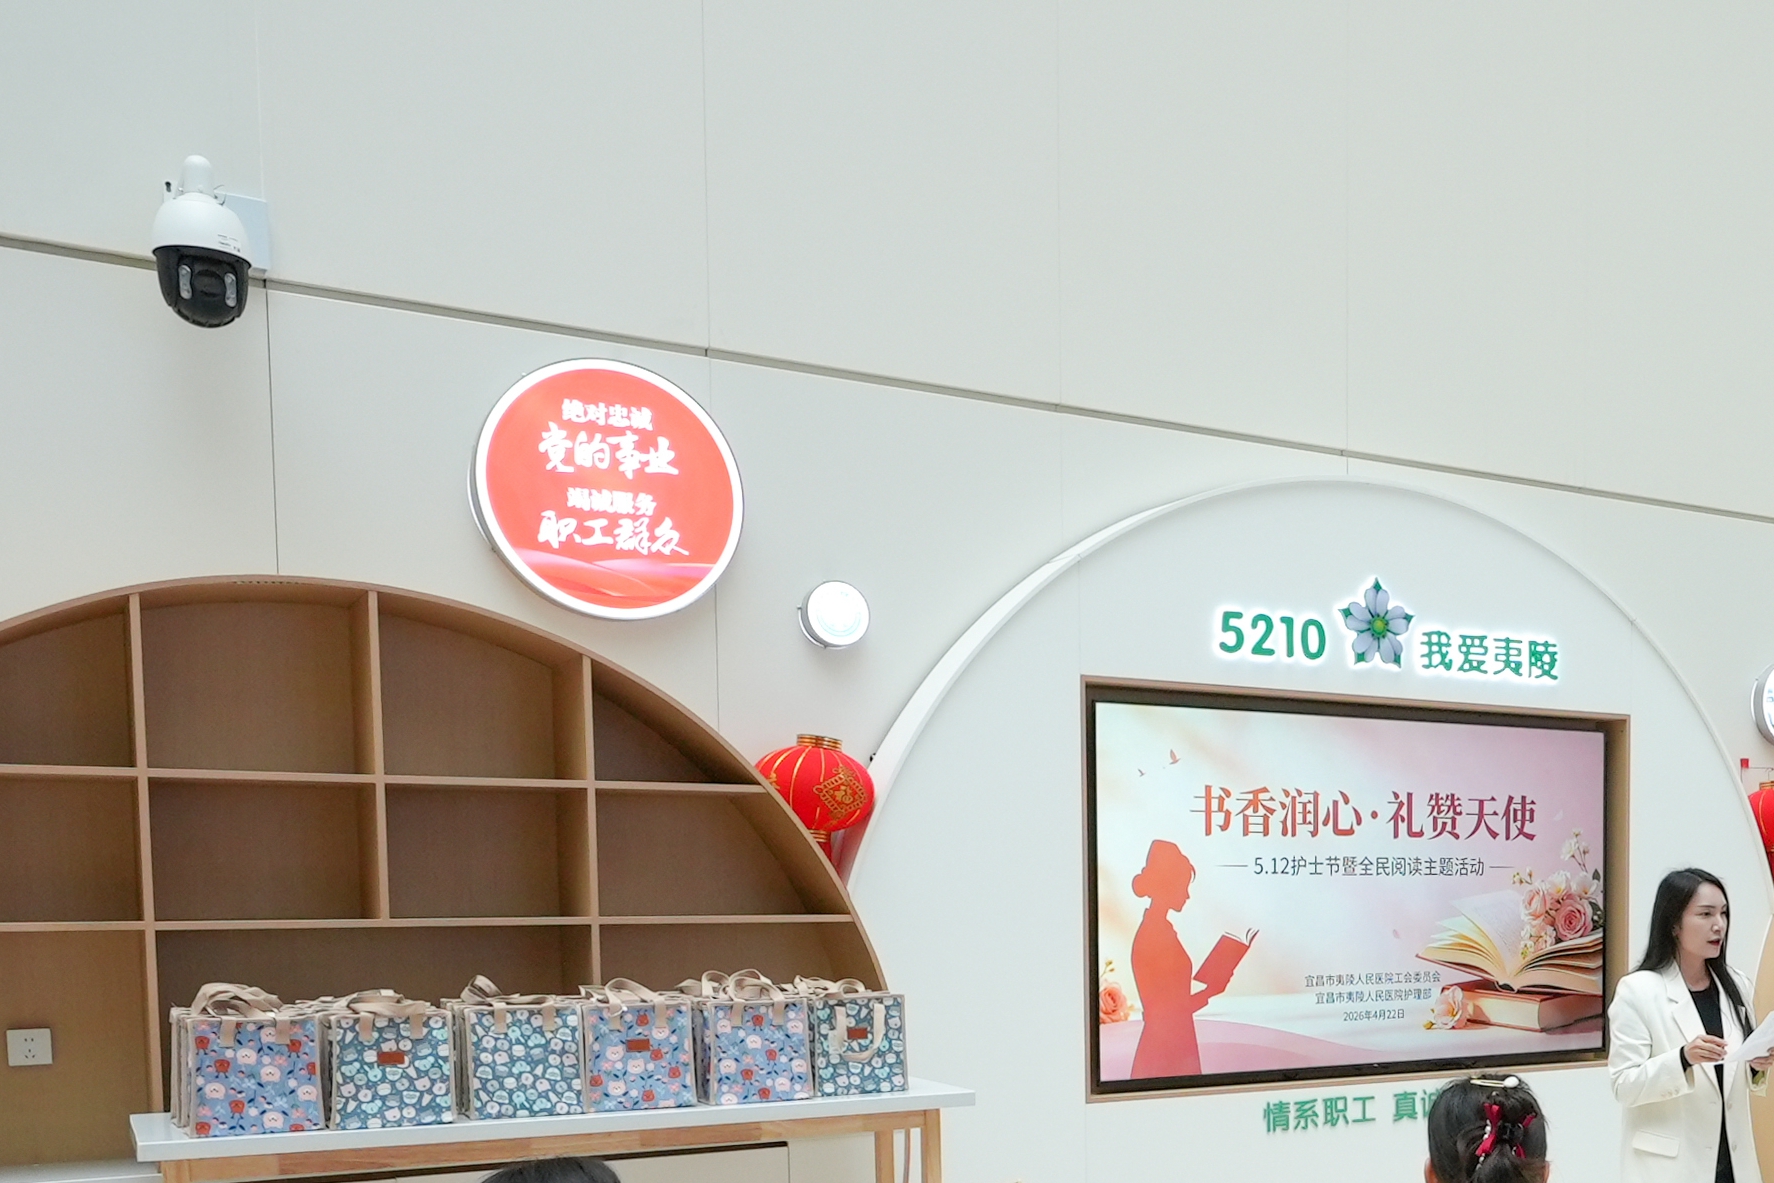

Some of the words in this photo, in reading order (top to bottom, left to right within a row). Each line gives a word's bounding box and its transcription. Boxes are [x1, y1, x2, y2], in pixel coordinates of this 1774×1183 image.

[561, 398, 654, 431] 绝对忠诚
[538, 421, 680, 480] 党的事业
[537, 510, 690, 556] 职工群众
[1218, 610, 1326, 660] 5210
[1419, 629, 1559, 681] 我爱夷陵
[1189, 784, 1537, 841] 书香润心·礼赞天使
[1253, 855, 1485, 877] 5.12护士节暨全民阅读主题活动
[1304, 970, 1441, 988] 宜昌市夷陵人民医院工会委员会
[1315, 987, 1432, 1005] 宜昌市夷陵人民医院护理部
[1343, 1008, 1405, 1022] 2026年4月22日
[1263, 1097, 1376, 1133] 情系职工
